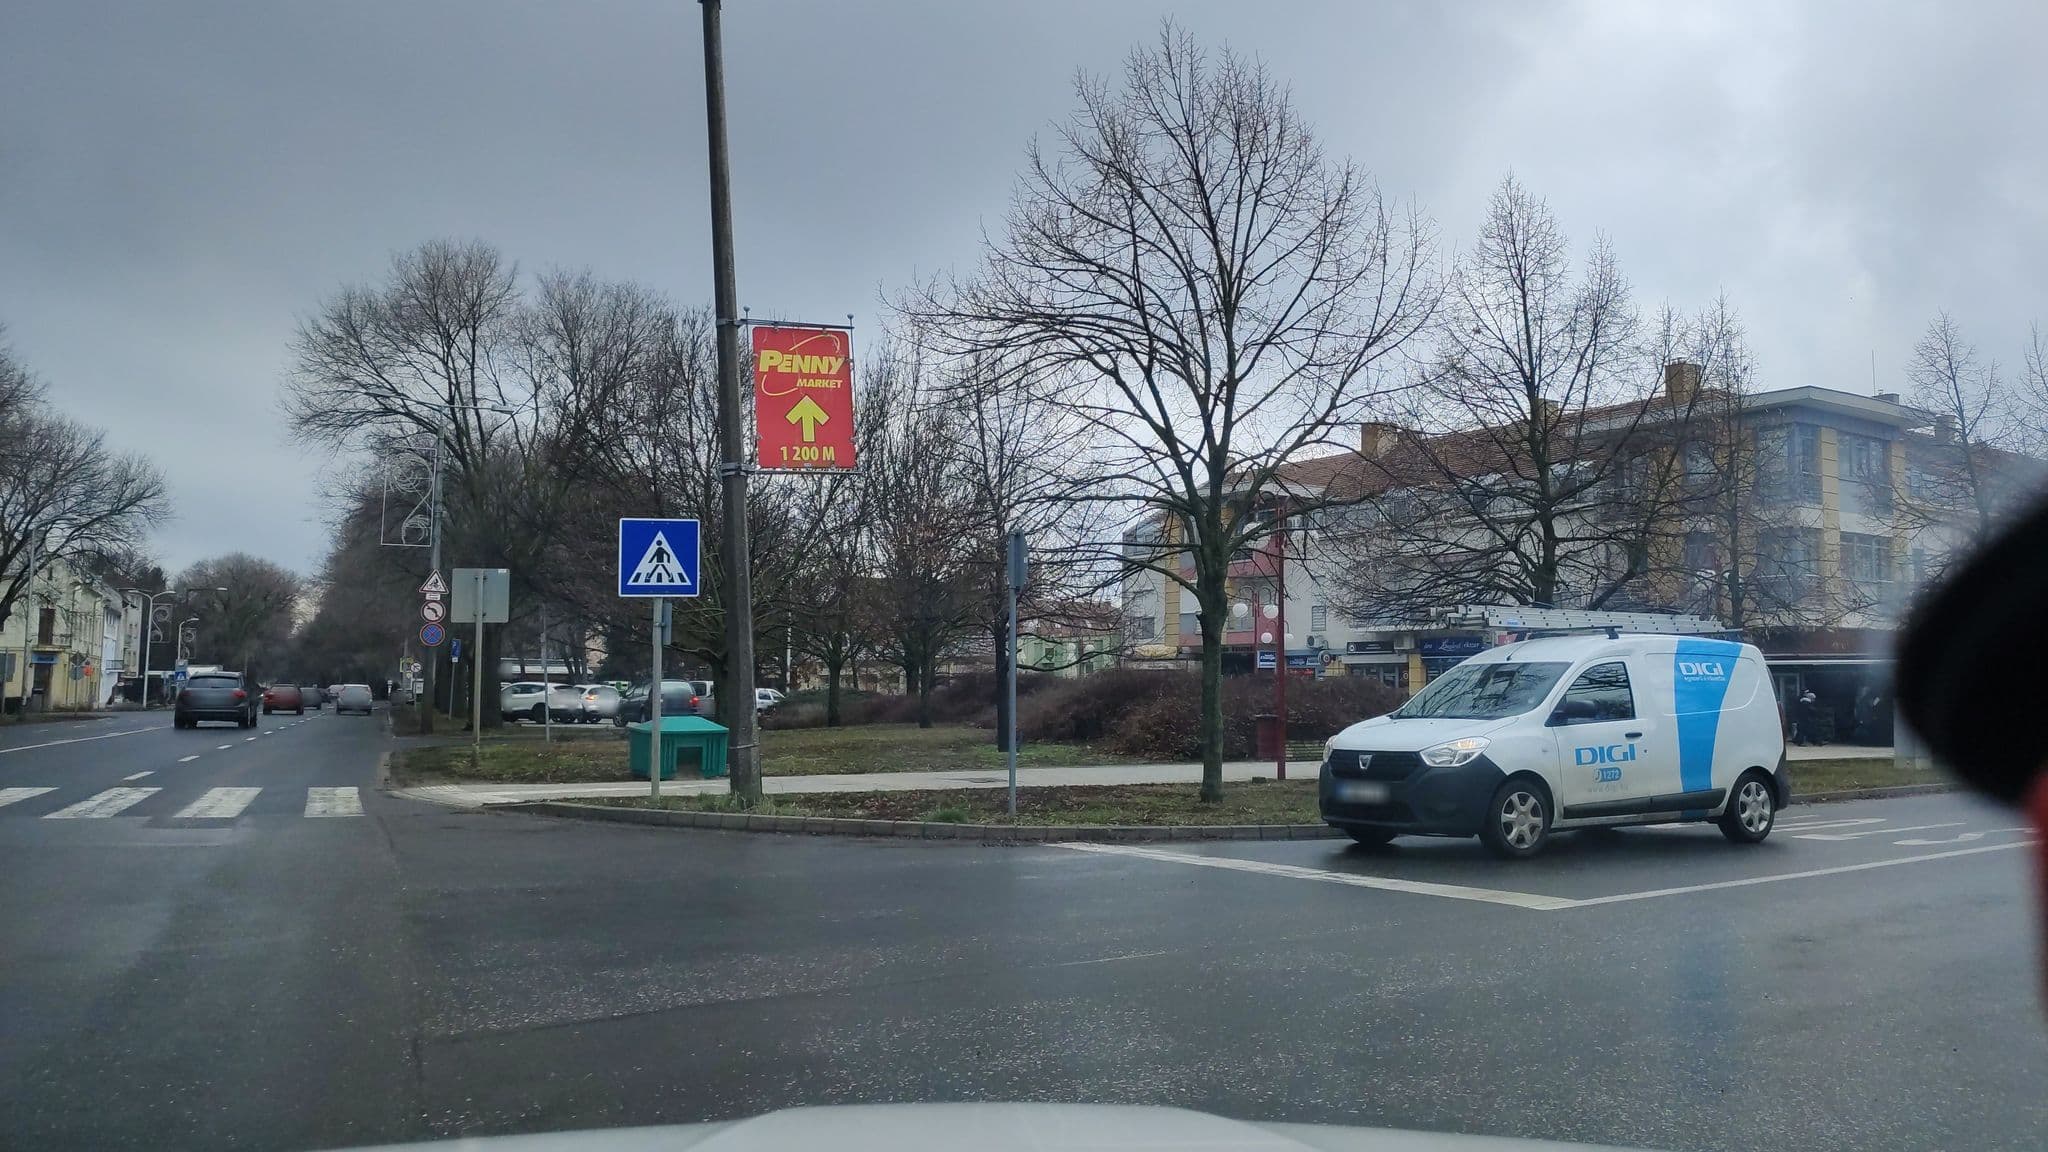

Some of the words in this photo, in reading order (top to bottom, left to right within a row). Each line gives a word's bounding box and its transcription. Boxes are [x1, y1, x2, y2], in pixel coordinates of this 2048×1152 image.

[759, 350, 845, 375] PENNY
[796, 378, 843, 389] MARKET
[780, 446, 788, 461] 1
[792, 446, 819, 461] 200
[822, 446, 835, 461] M
[1678, 662, 1725, 676] DIGI
[1575, 743, 1636, 766] DIGI
[1603, 770, 1620, 780] 1272
